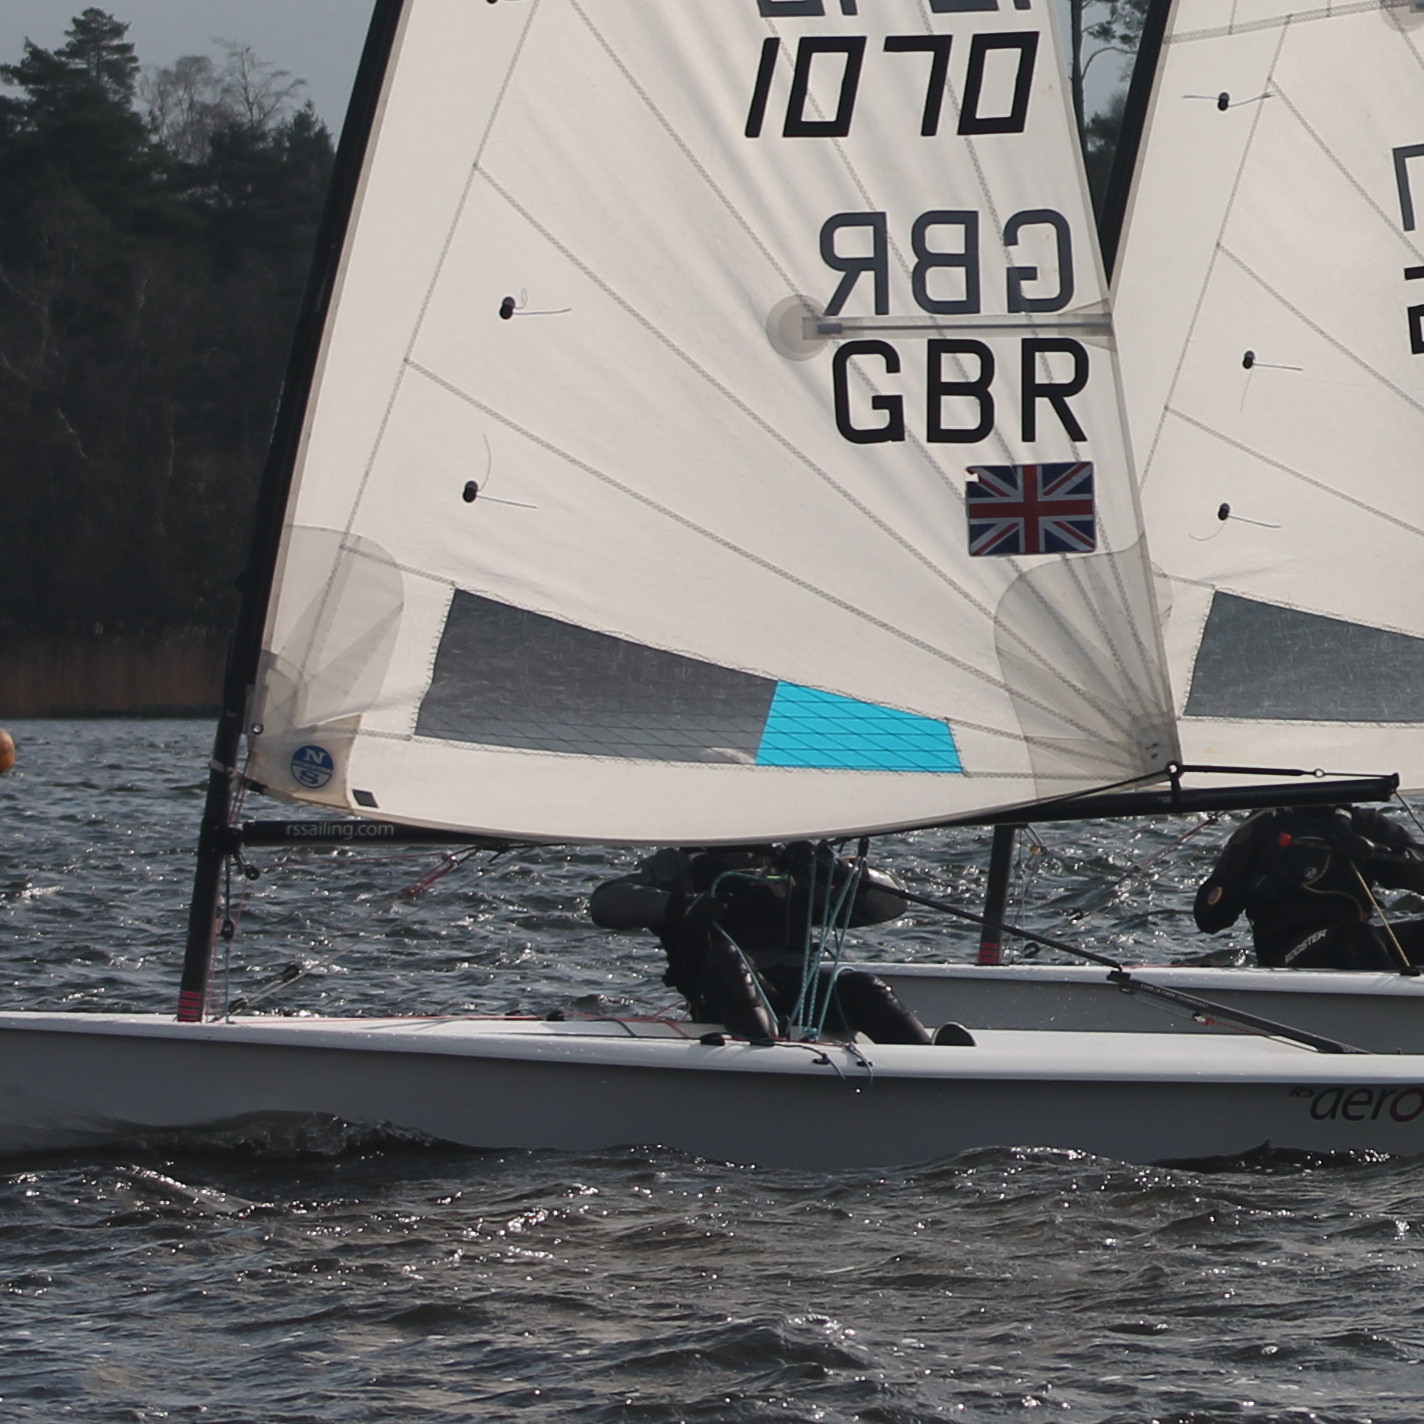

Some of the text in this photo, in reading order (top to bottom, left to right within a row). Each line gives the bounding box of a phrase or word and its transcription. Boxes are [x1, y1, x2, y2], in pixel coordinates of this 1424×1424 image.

[744, 31, 1040, 138] 1070
[832, 337, 1090, 444] GBR
[303, 748, 326, 765] N
[285, 821, 396, 840] rssailing.com
[1288, 1086, 1318, 1098] RS
